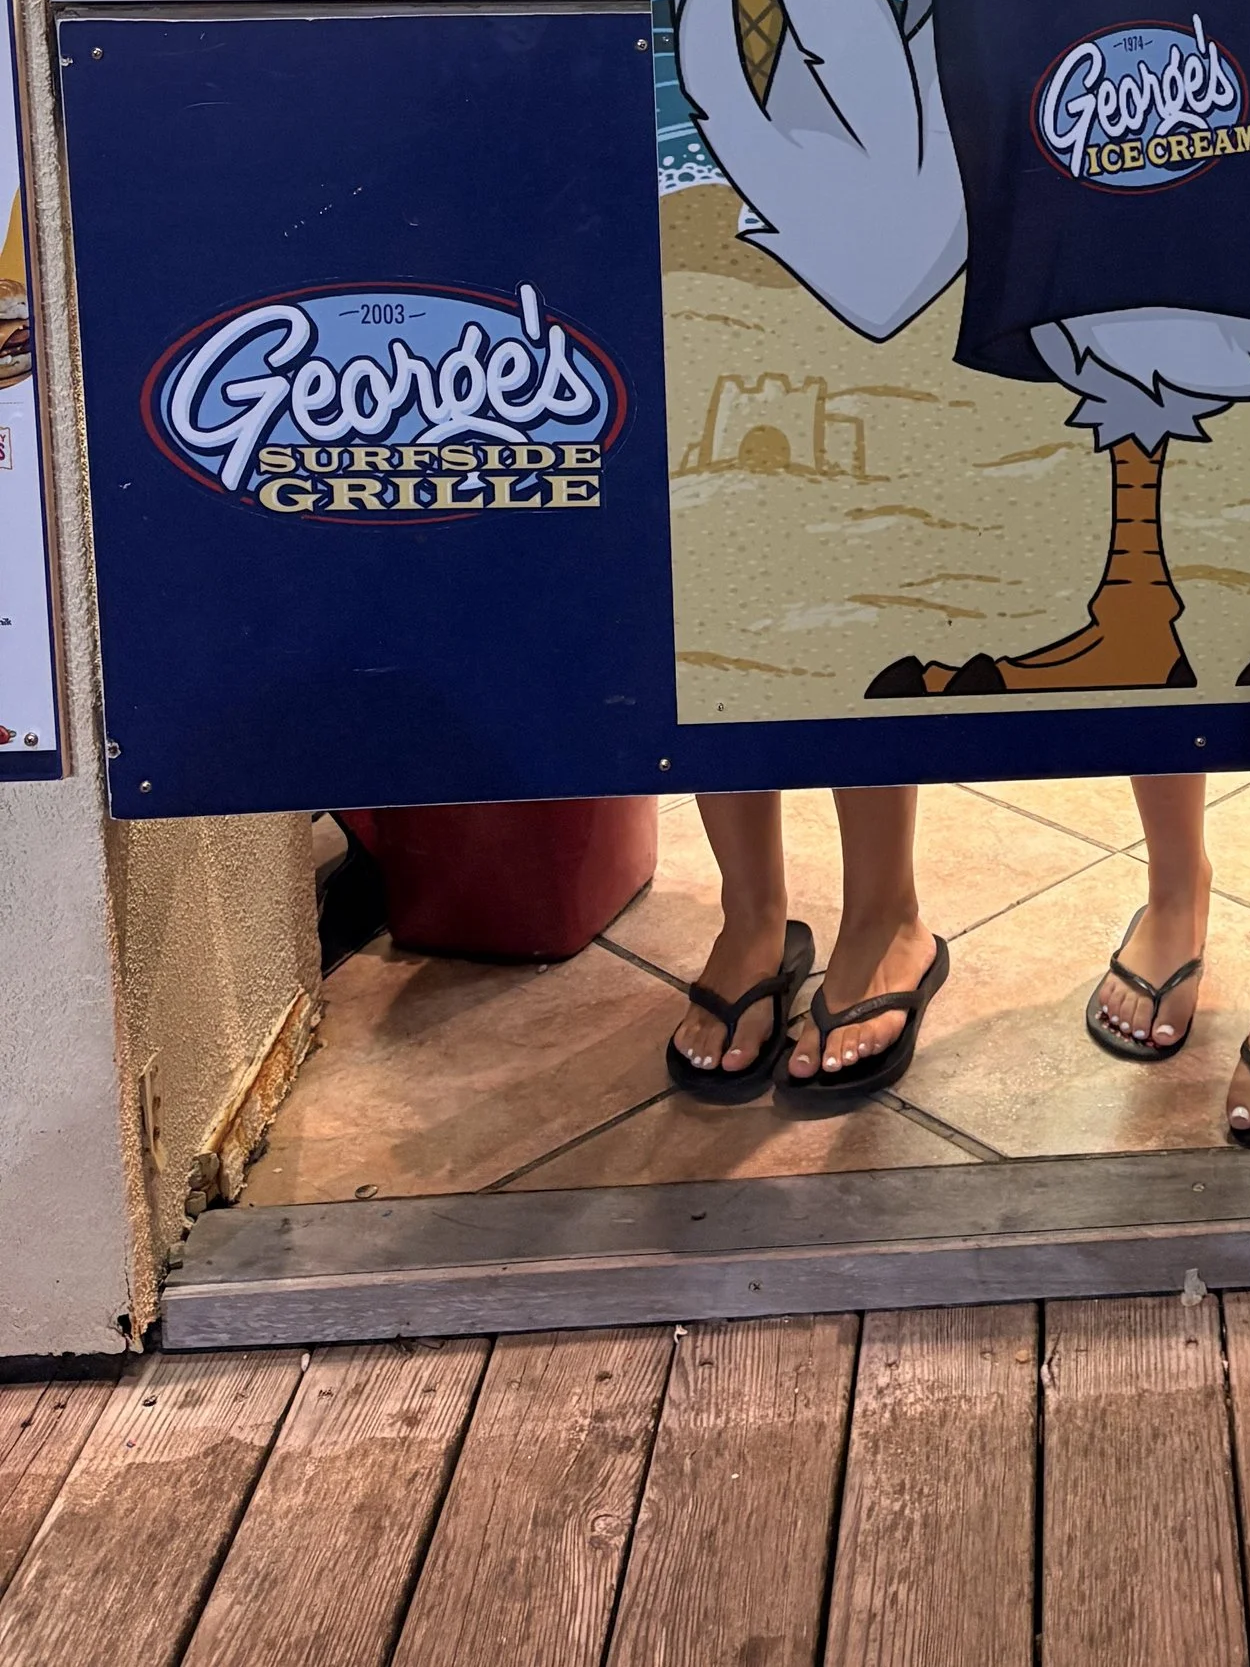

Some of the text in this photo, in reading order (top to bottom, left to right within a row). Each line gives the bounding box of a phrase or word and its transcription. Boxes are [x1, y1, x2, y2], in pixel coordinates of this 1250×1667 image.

[1043, 13, 1235, 178] George's
[1086, 140, 1144, 174] ICE
[170, 283, 594, 491] George's
[258, 443, 601, 473] SURFSIDE
[258, 474, 601, 513] GRILLE
